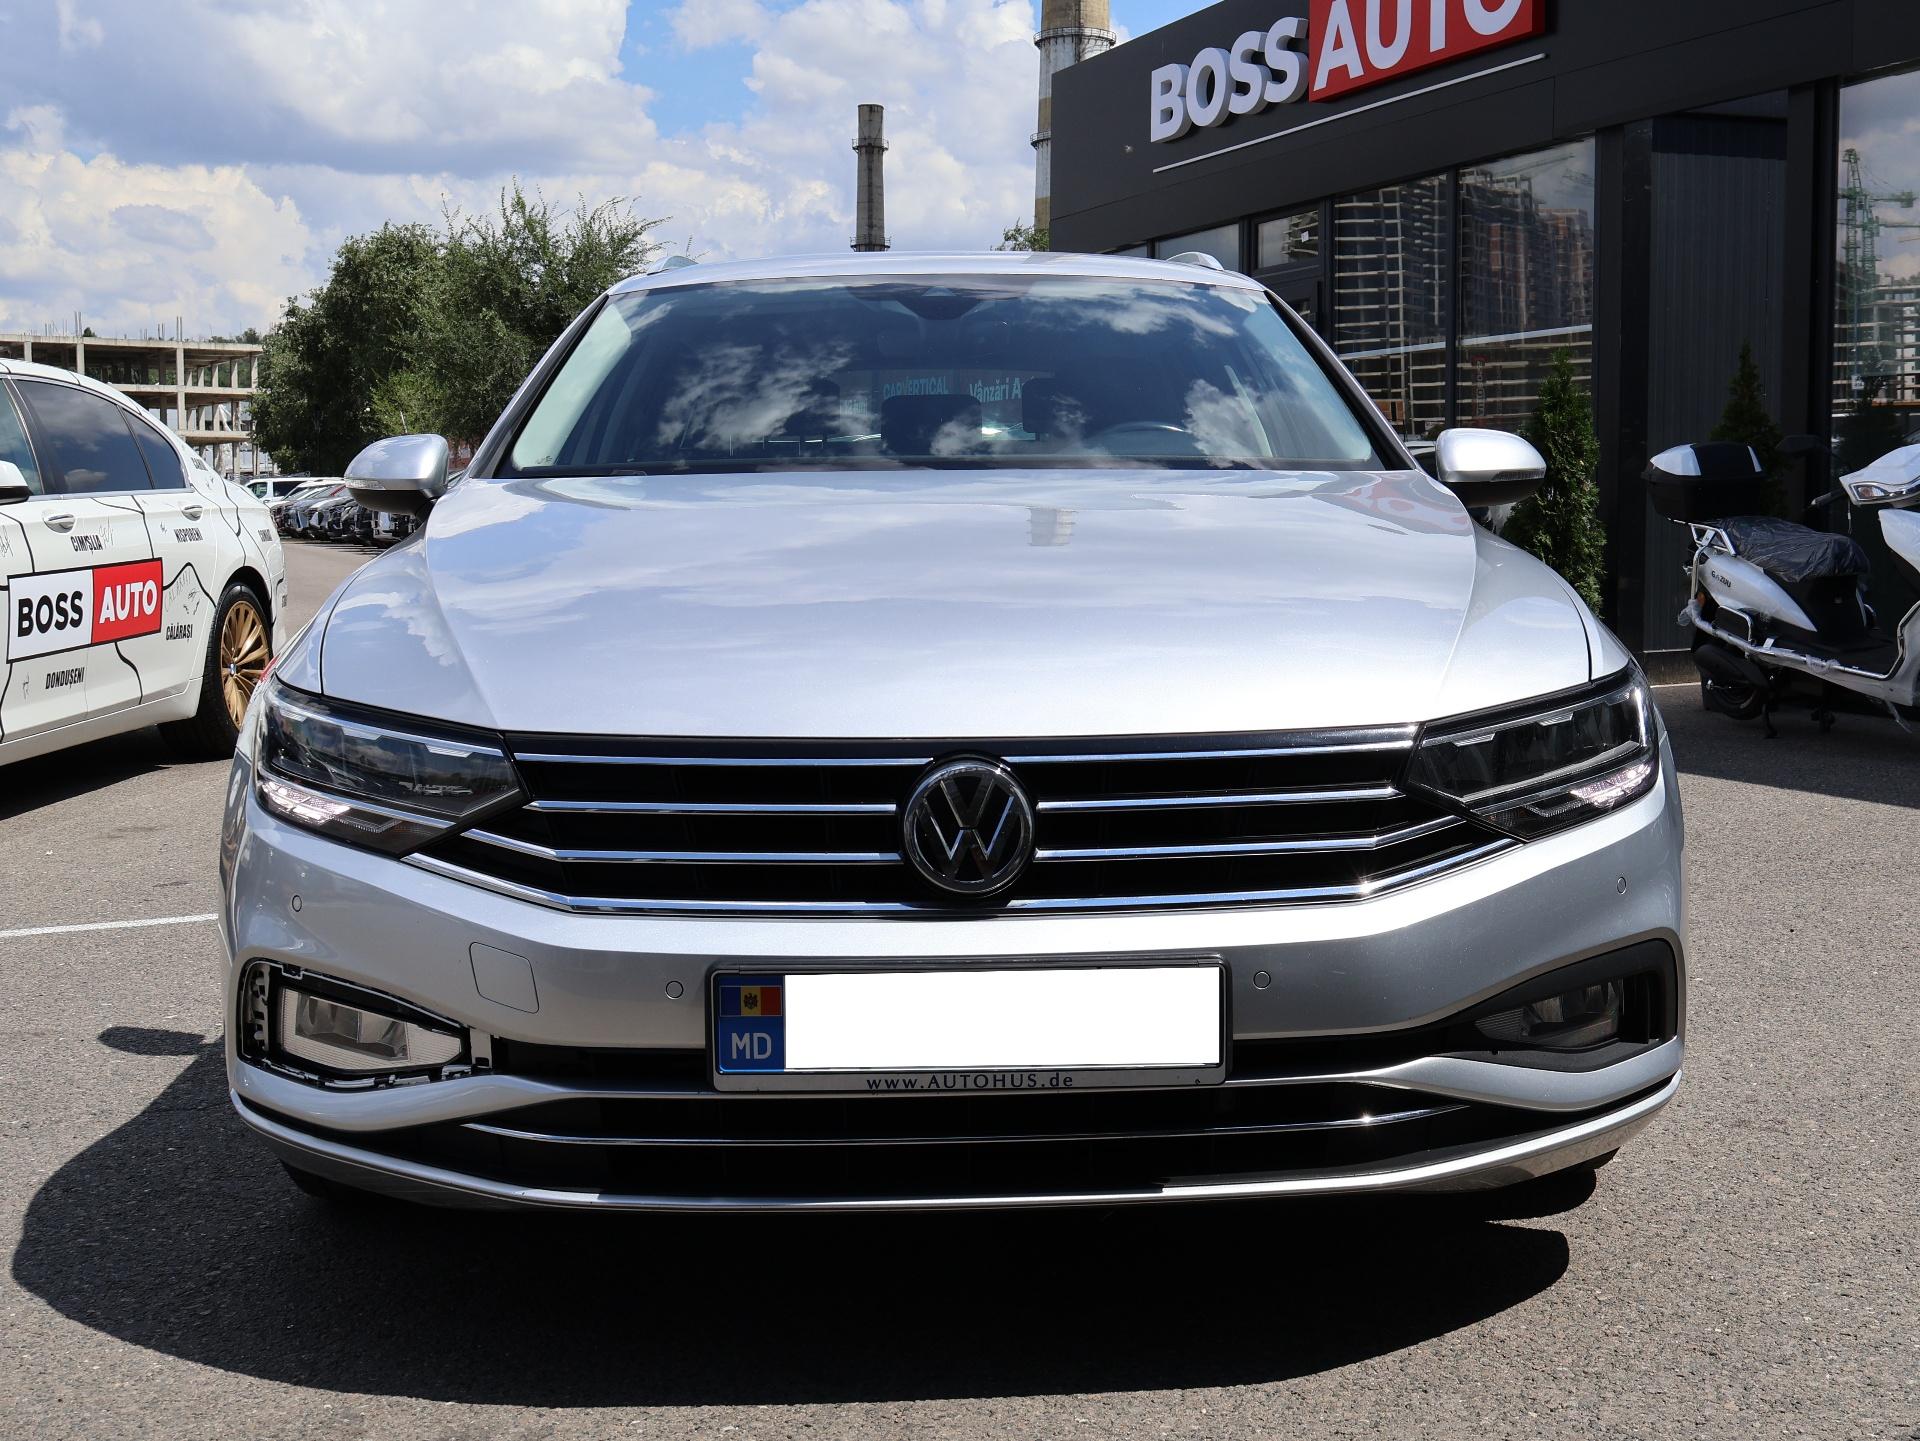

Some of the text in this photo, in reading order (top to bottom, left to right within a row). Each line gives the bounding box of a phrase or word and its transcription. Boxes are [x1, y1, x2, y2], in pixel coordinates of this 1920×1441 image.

[1150, 16, 1309, 142] BOSS
[18, 590, 84, 637] BOSS
[99, 579, 158, 624] AUTO
[731, 1032, 772, 1060] MD
[866, 1072, 1074, 1090] www.AUTOHUS.de
